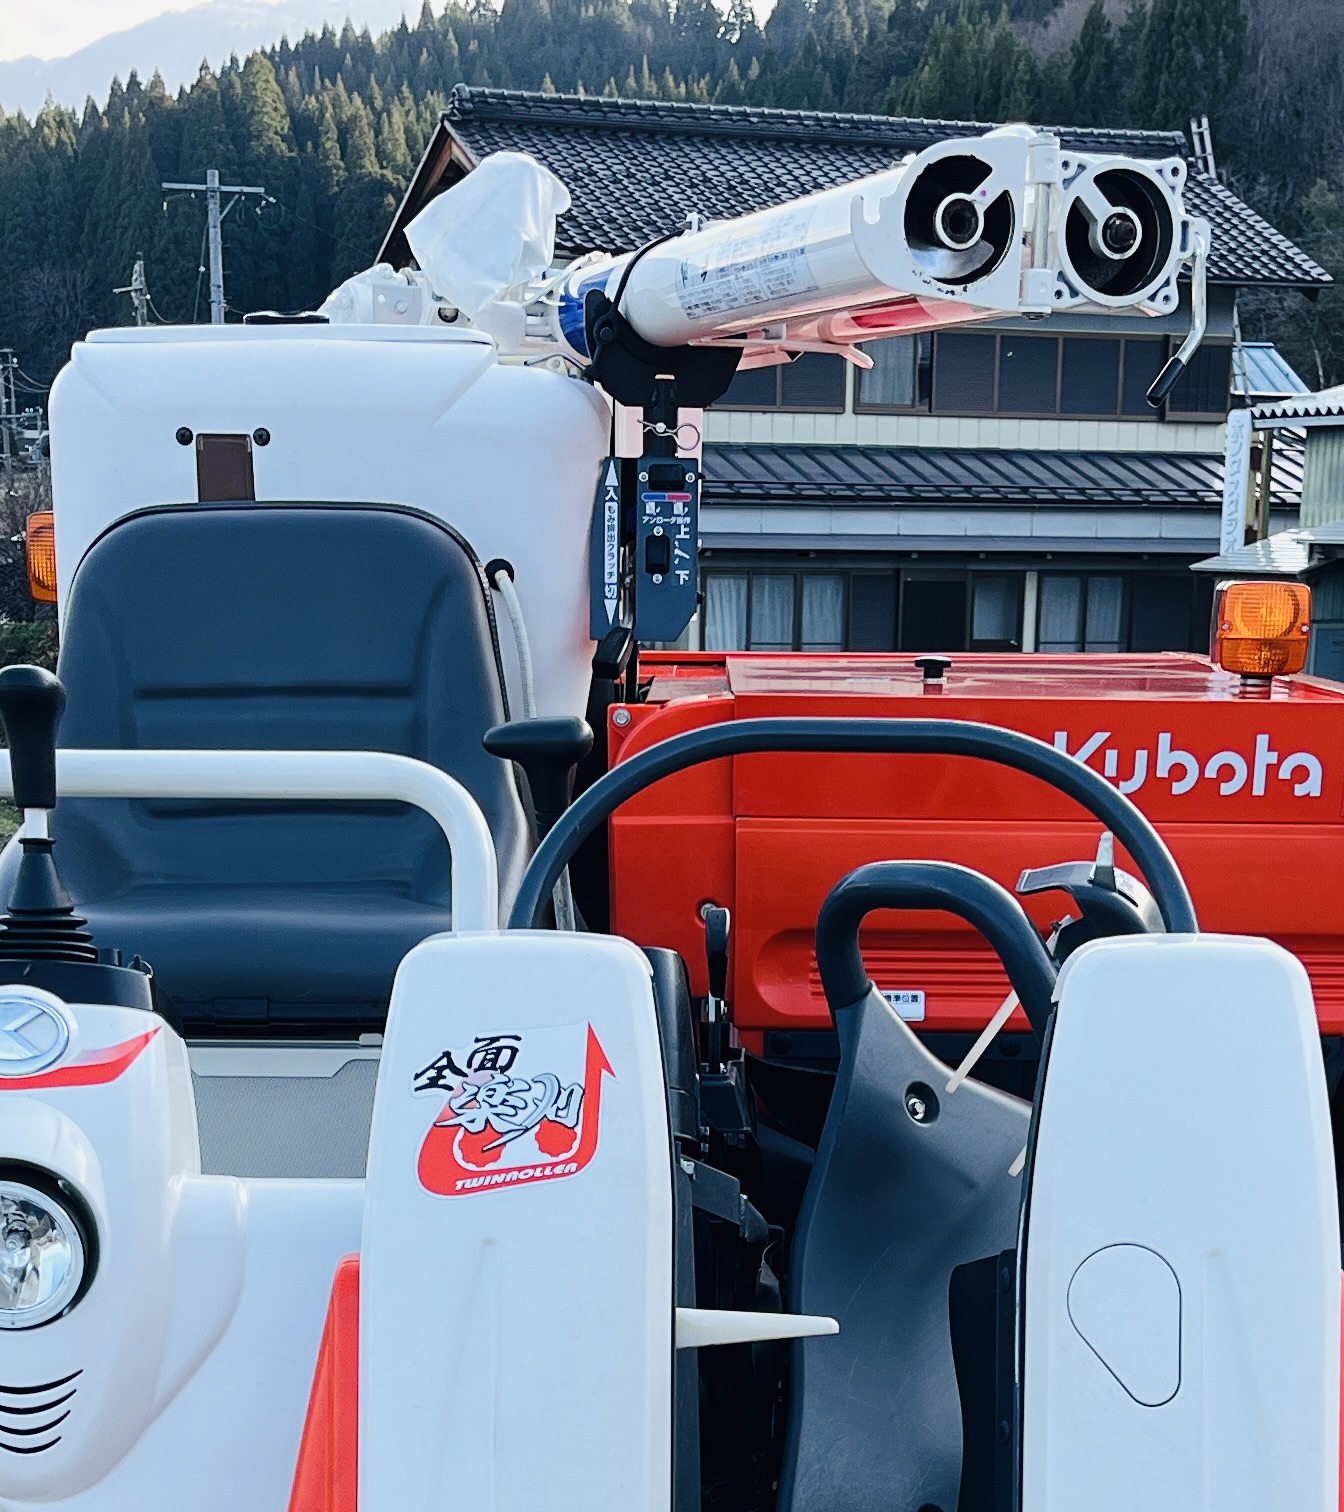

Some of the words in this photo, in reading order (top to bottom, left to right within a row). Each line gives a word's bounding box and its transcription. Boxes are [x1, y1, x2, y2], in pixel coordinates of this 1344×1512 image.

[604, 486, 619, 501] 入
[675, 524, 691, 539] 上
[675, 569, 690, 585] 下
[1054, 731, 1323, 798] Kubota
[455, 1162, 578, 1191] TWINROLLER
